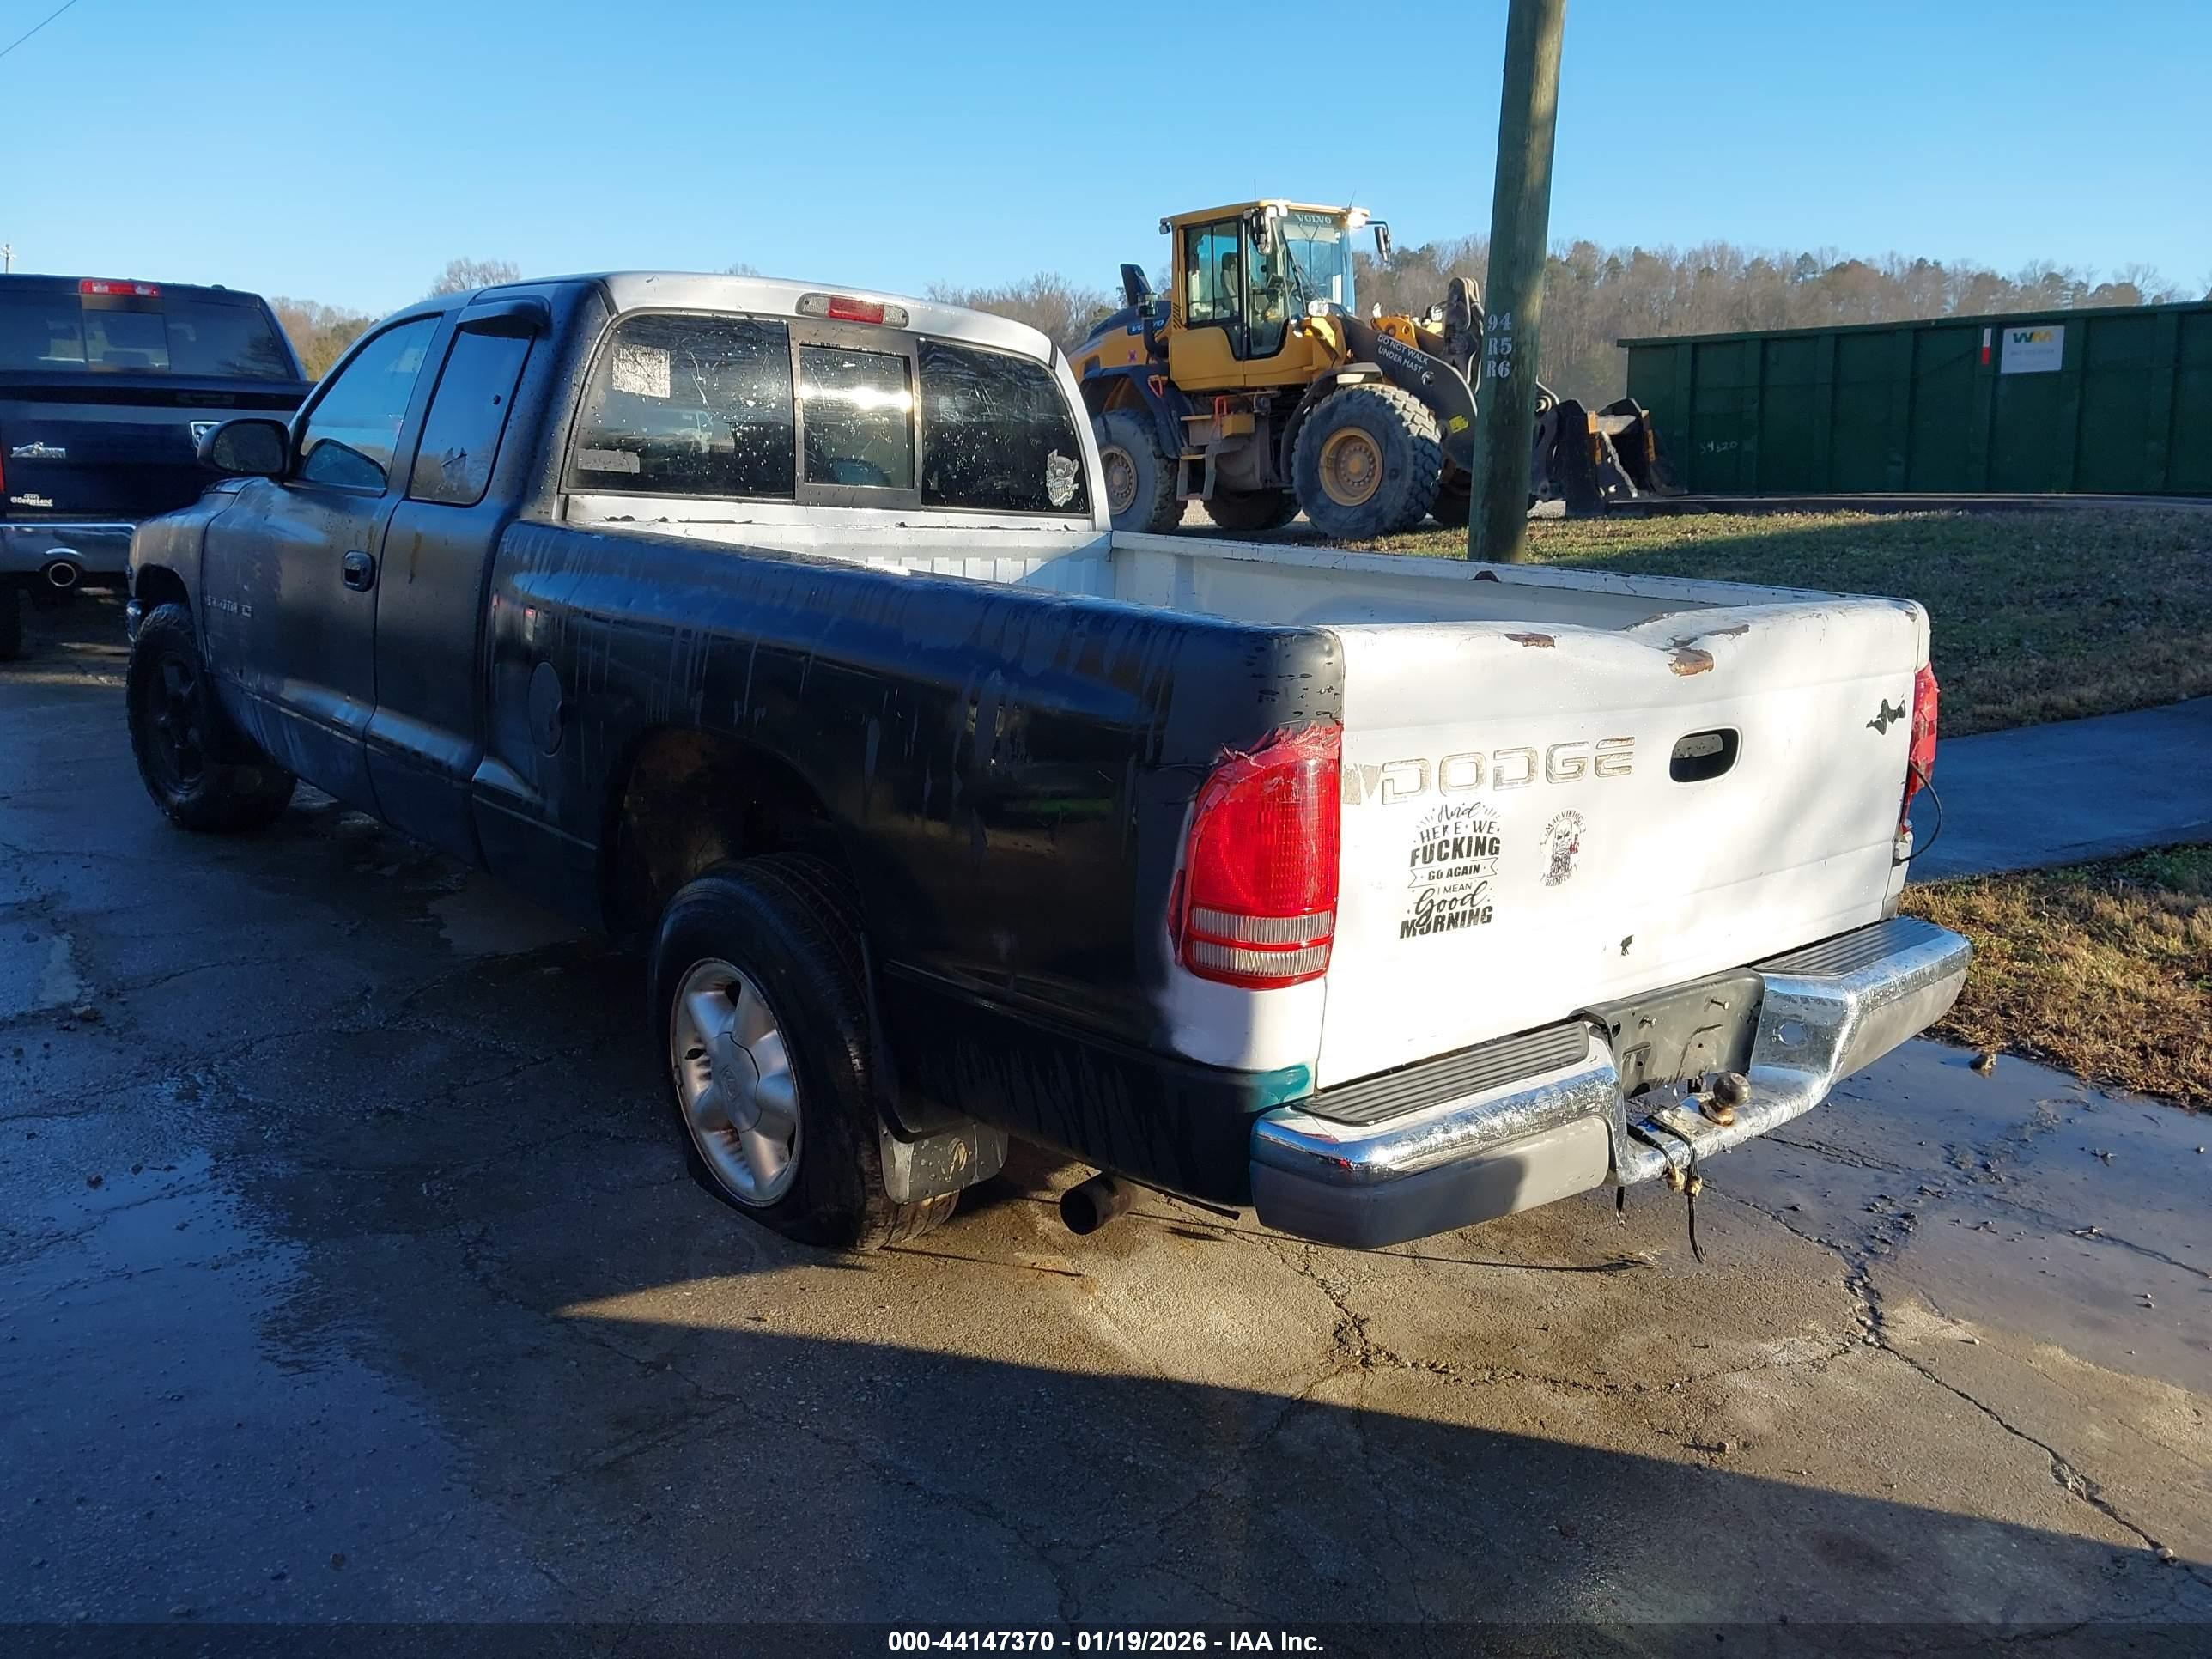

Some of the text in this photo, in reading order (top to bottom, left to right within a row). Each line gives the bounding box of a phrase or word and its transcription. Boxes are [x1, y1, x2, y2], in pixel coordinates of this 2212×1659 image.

[1295, 214, 1332, 224] VOLVO
[1487, 312, 1511, 331] 94
[2013, 330, 2054, 343] WM
[1377, 334, 1429, 365] DO NOT WALK
[1487, 337, 1512, 356] R5
[1378, 346, 1424, 373] UNDER MAST
[1486, 360, 1510, 379] R6
[1382, 737, 1636, 805] DODGE
[1437, 801, 1481, 823] And
[1473, 820, 1498, 835] WE
[1410, 836, 1501, 867] FUCKING
[1428, 864, 1480, 881] GO AGAIN
[1443, 882, 1473, 894] MEAN
[1414, 880, 1488, 928] Good
[1400, 905, 1493, 939] MORNING
